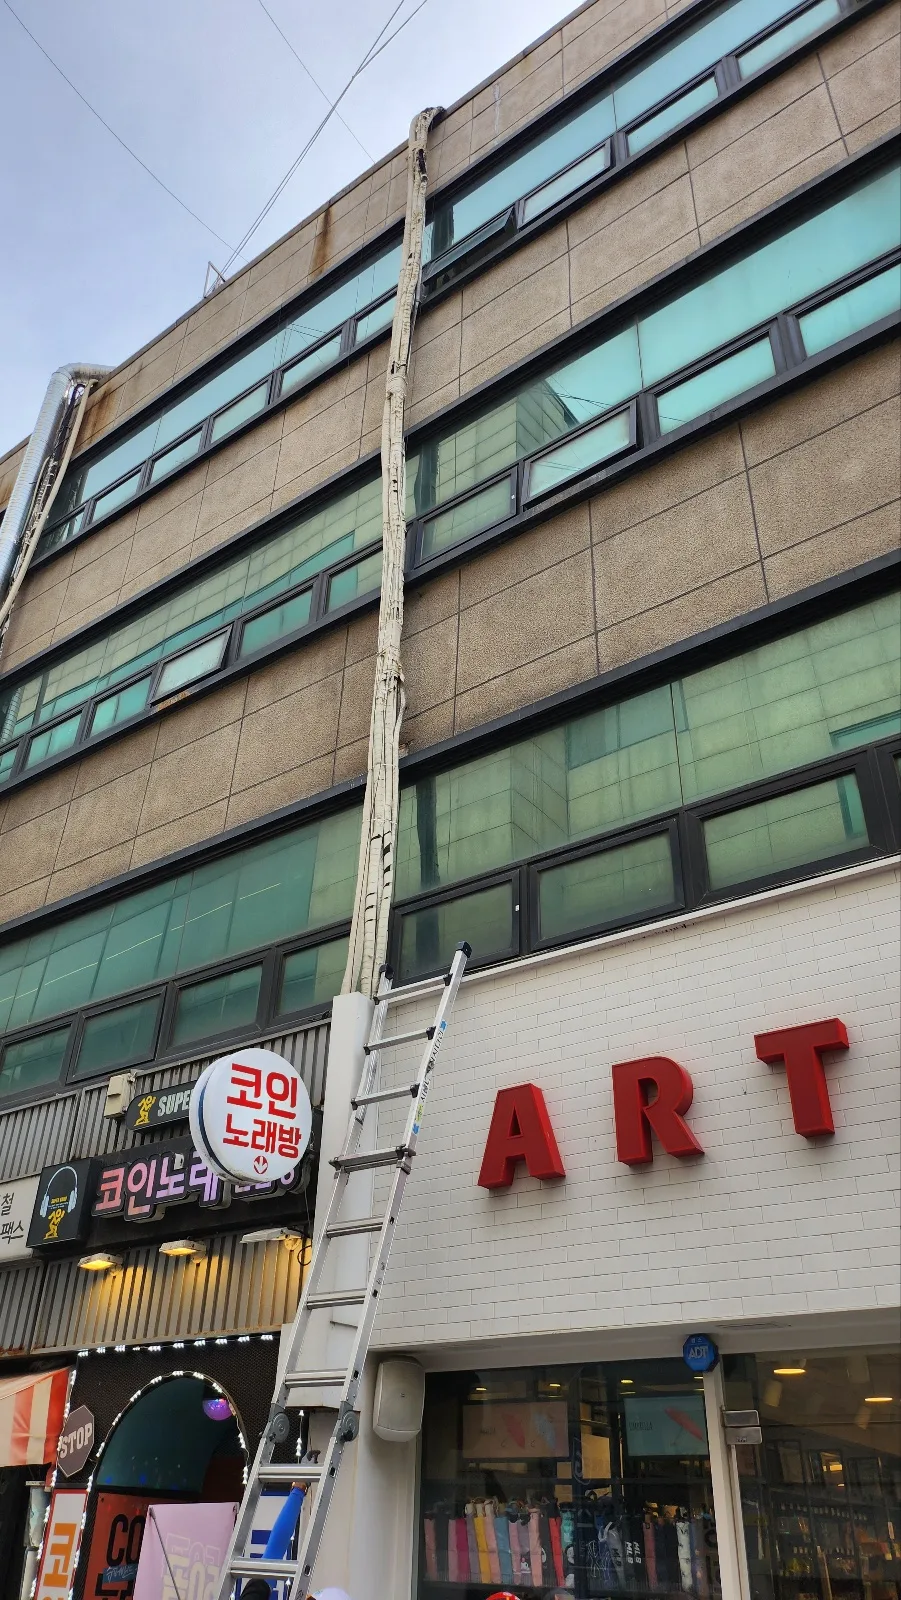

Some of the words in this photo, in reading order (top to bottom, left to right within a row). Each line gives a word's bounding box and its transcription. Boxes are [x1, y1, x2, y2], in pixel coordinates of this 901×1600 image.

[157, 1088, 194, 1117] SUPE
[227, 1063, 298, 1120] 코인
[477, 1017, 850, 1190] ART
[222, 1113, 302, 1159] 노래방
[0, 1220, 24, 1245] 팩스
[687, 1345, 709, 1360] ADT
[59, 1422, 93, 1459] STOP
[43, 1523, 77, 1600] 코
[626, 1541, 634, 1564] MLB
[633, 1541, 642, 1564] MLB
